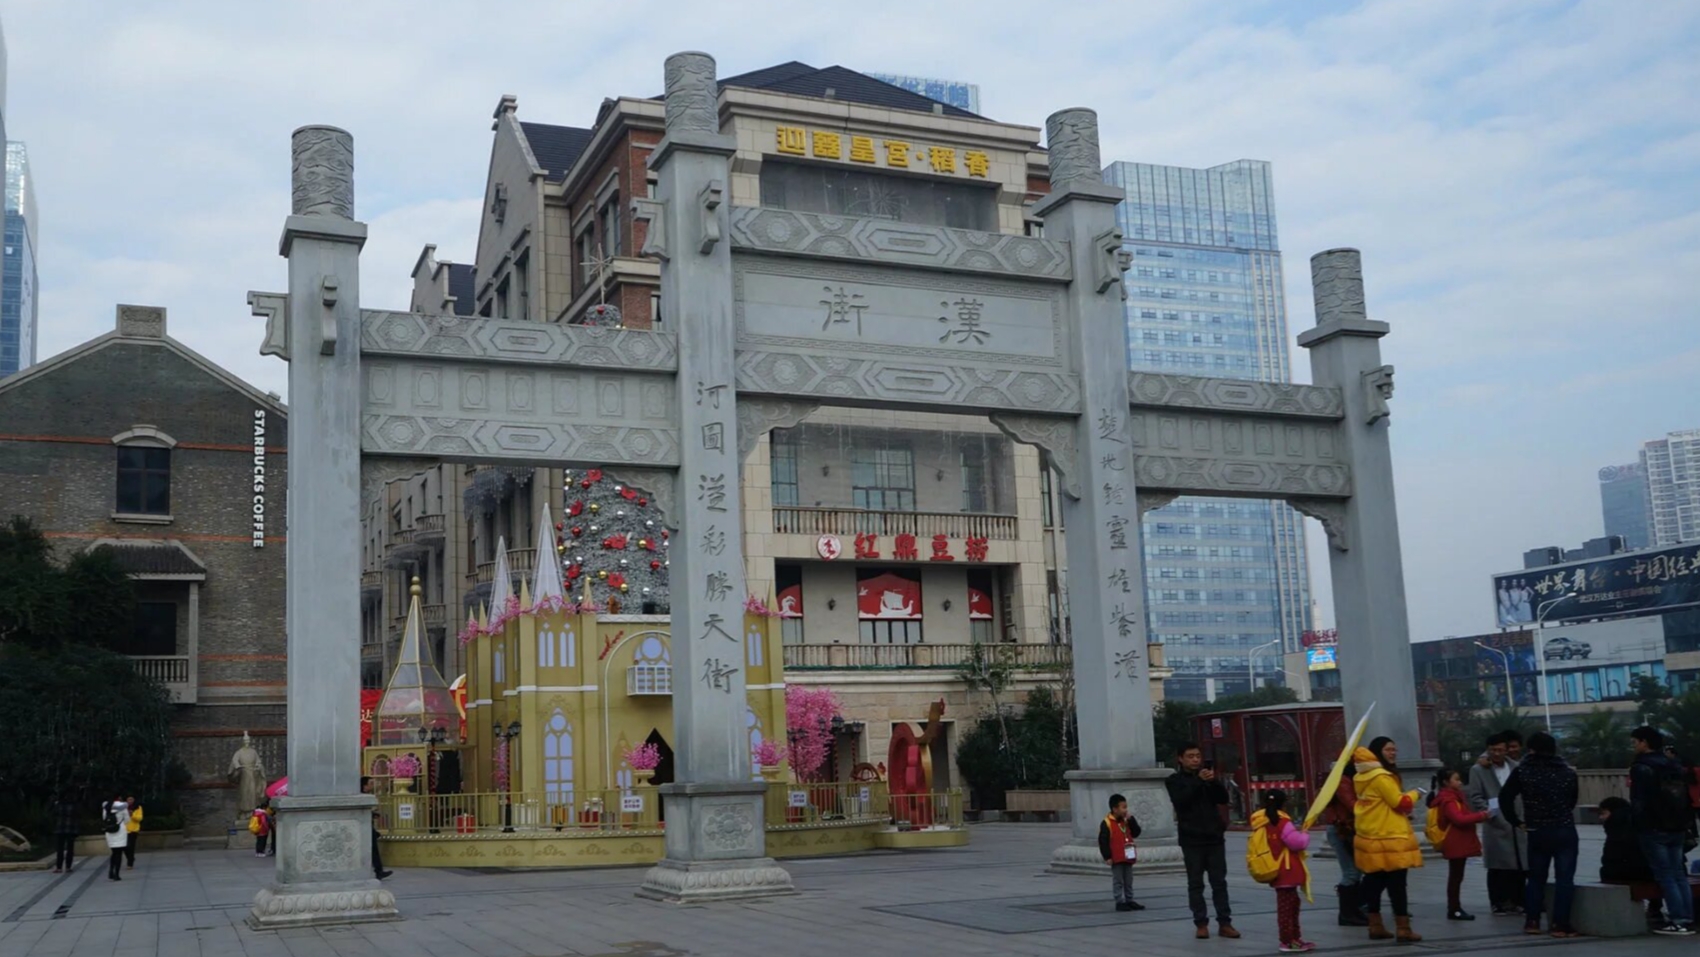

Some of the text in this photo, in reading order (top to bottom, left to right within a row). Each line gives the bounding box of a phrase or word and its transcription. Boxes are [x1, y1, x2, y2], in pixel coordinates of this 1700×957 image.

[252, 409, 265, 547] STARBUCKS COFFEE
[854, 531, 988, 562] 红鼎豆捞
